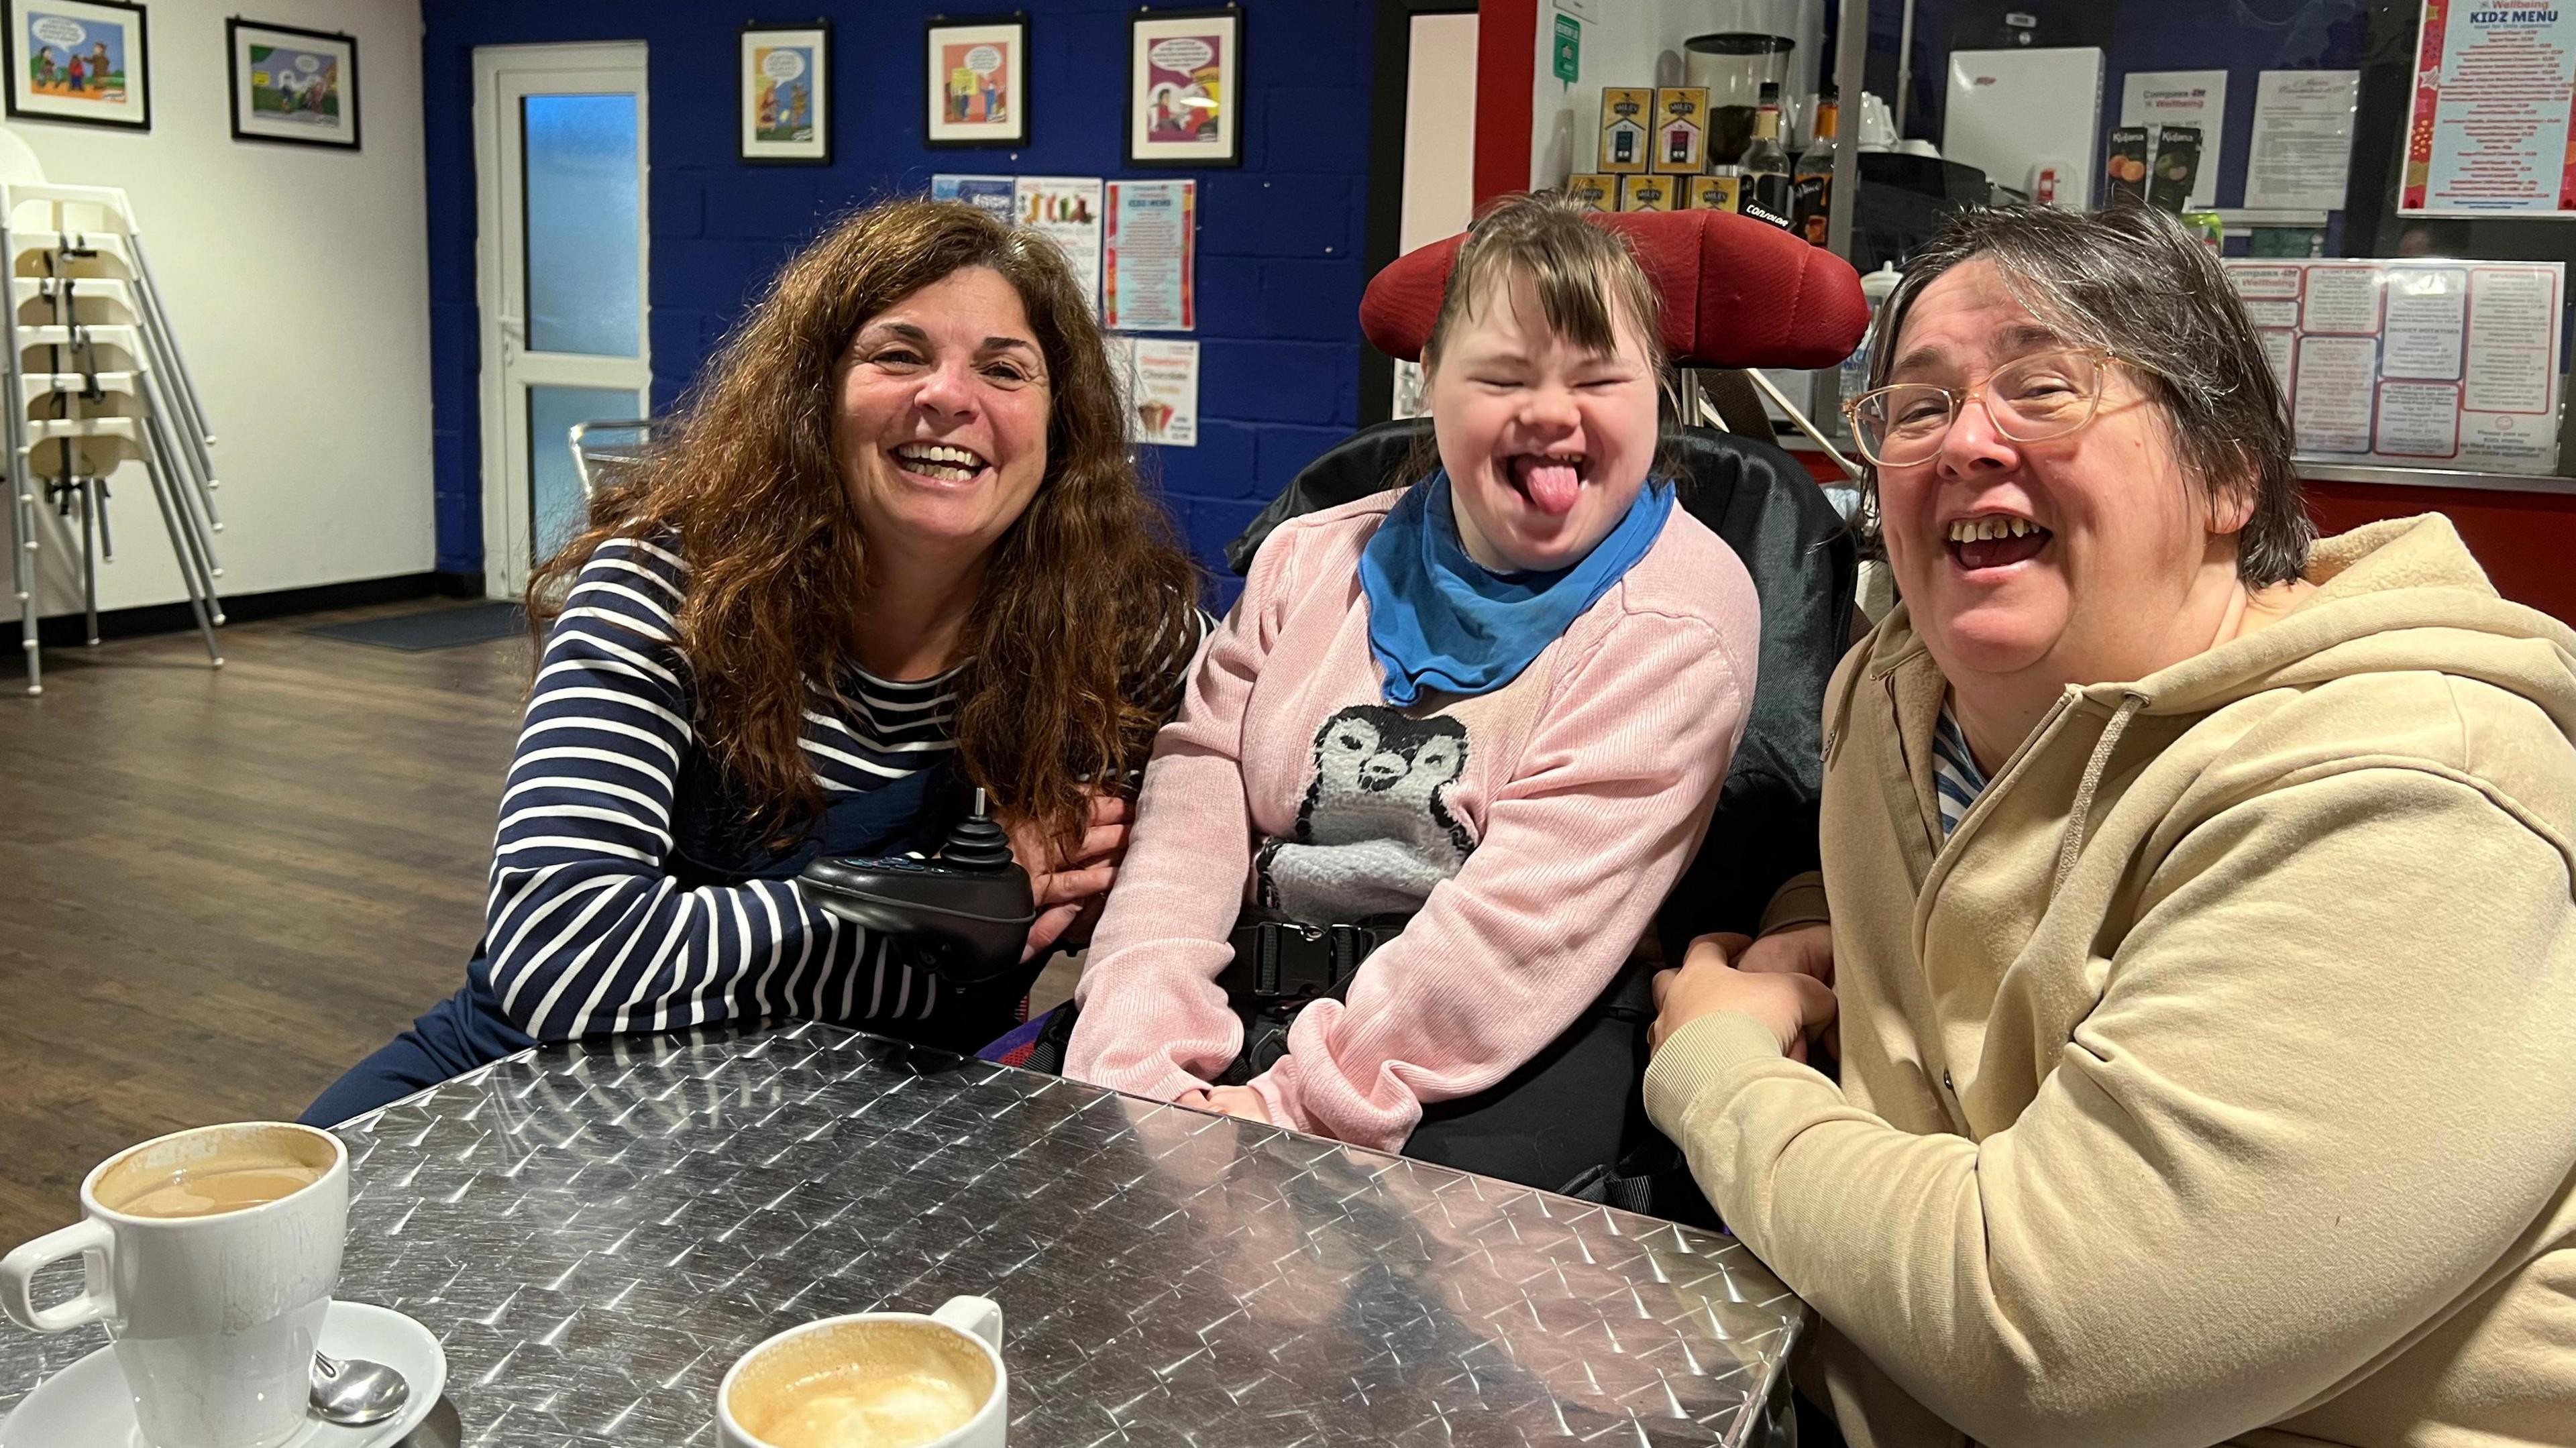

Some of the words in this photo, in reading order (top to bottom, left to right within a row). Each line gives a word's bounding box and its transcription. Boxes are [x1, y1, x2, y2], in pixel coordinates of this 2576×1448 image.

[2492, 0, 2550, 10] Wellbeing
[2470, 11, 2508, 23] KIDZ
[2512, 10, 2559, 22] MENU
[2242, 278, 2296, 288] Wellbeing
